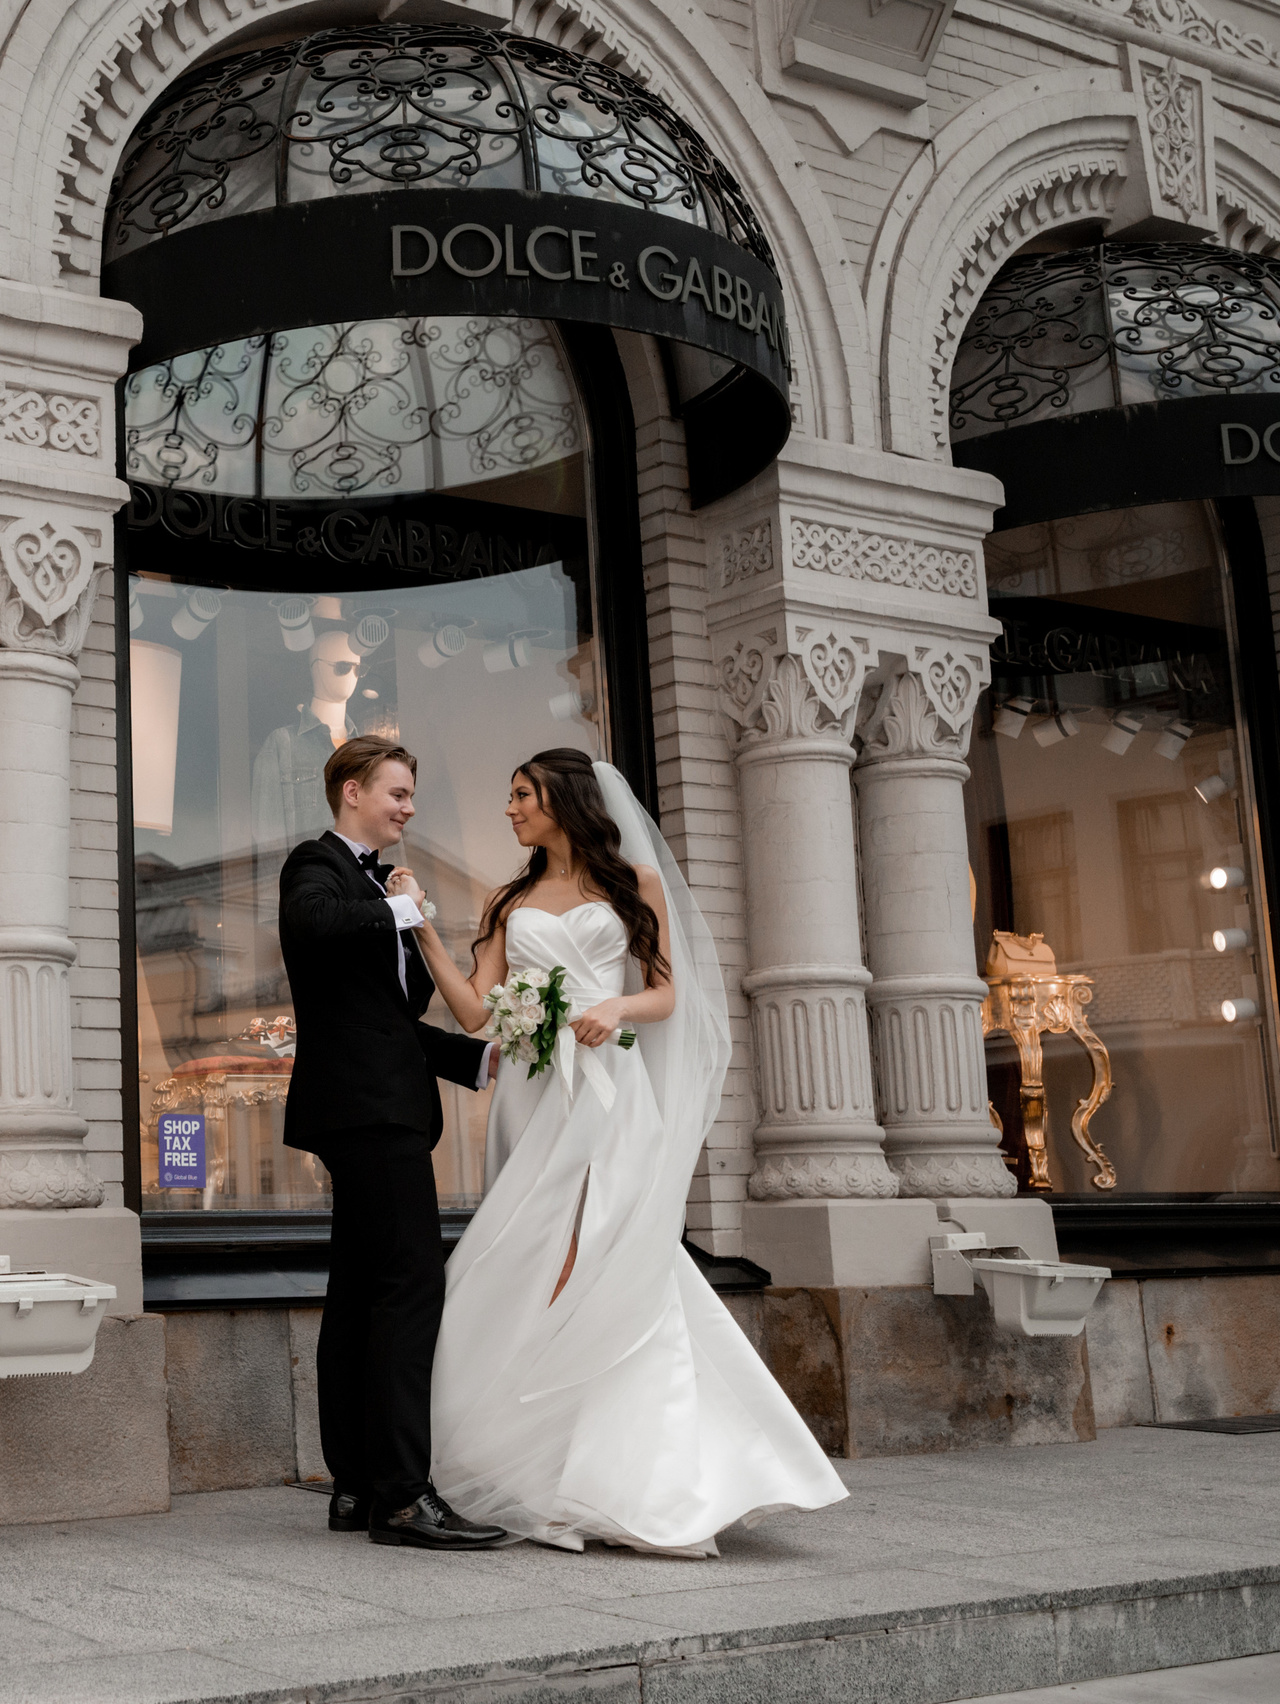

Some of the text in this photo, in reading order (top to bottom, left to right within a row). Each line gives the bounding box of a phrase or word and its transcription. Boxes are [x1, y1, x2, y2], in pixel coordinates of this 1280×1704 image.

[391, 223, 792, 382] DOLCE & GABBAN
[163, 1120, 200, 1135] SHOP
[163, 1136, 191, 1150] TAX
[164, 1152, 197, 1167] FREE
